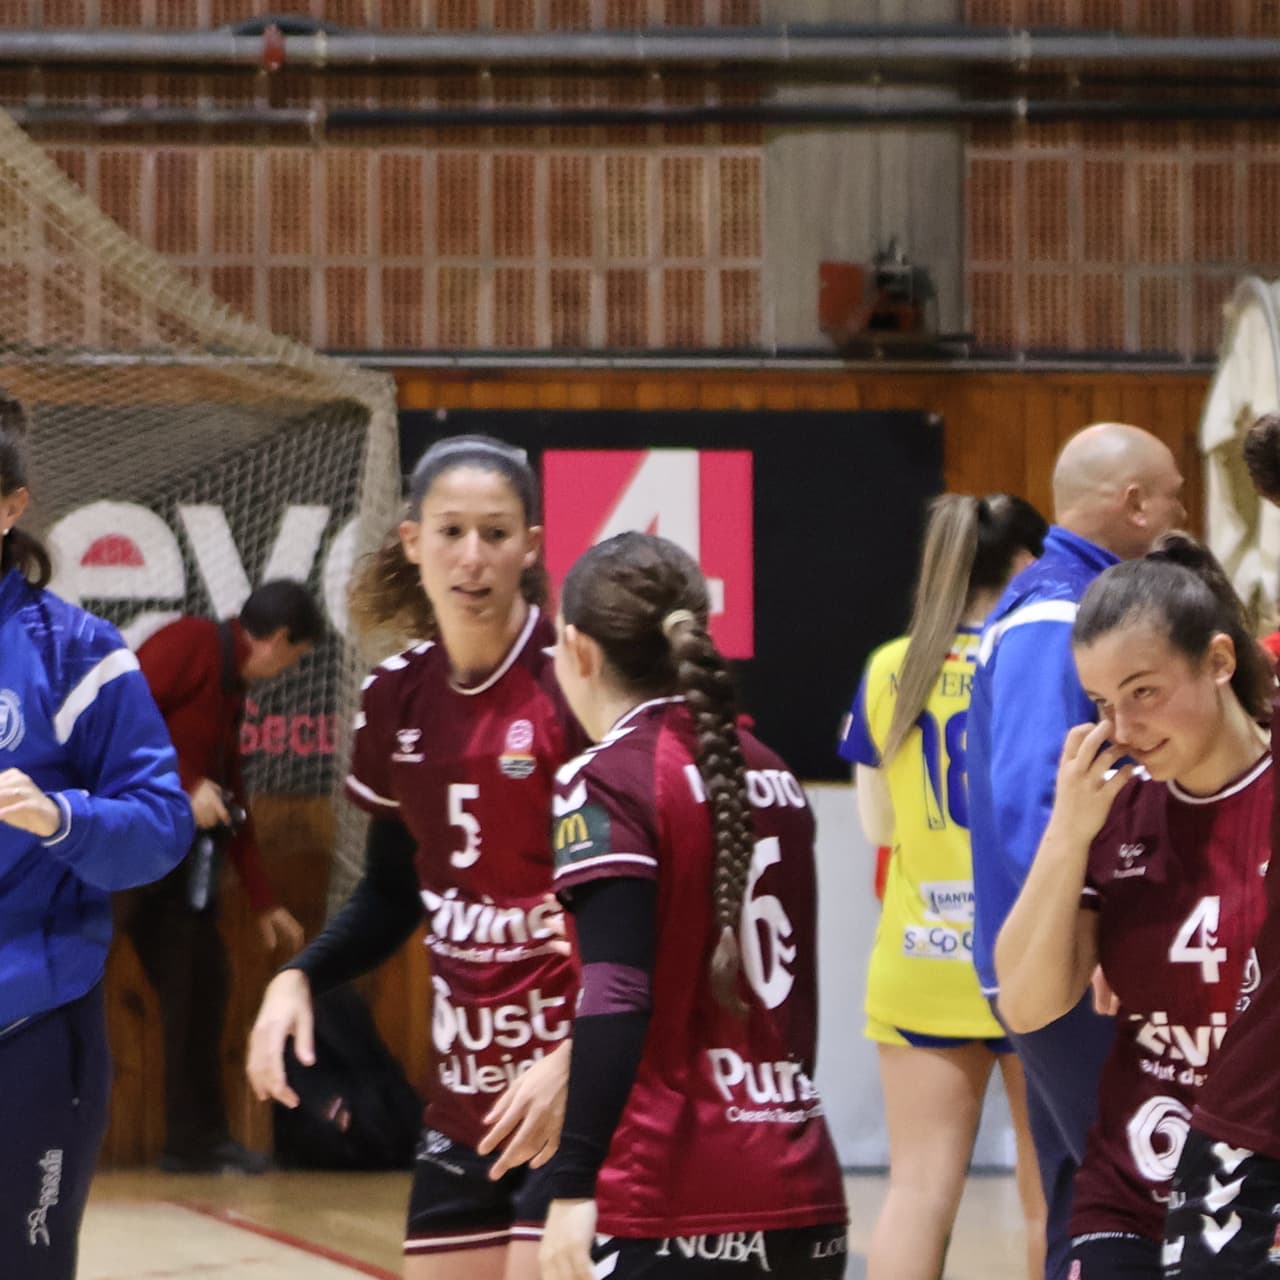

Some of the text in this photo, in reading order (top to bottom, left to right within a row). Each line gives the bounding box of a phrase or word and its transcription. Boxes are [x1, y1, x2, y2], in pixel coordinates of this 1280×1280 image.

[448, 783, 482, 868] 5
[741, 836, 797, 1009] 6
[1168, 895, 1228, 984] 4
